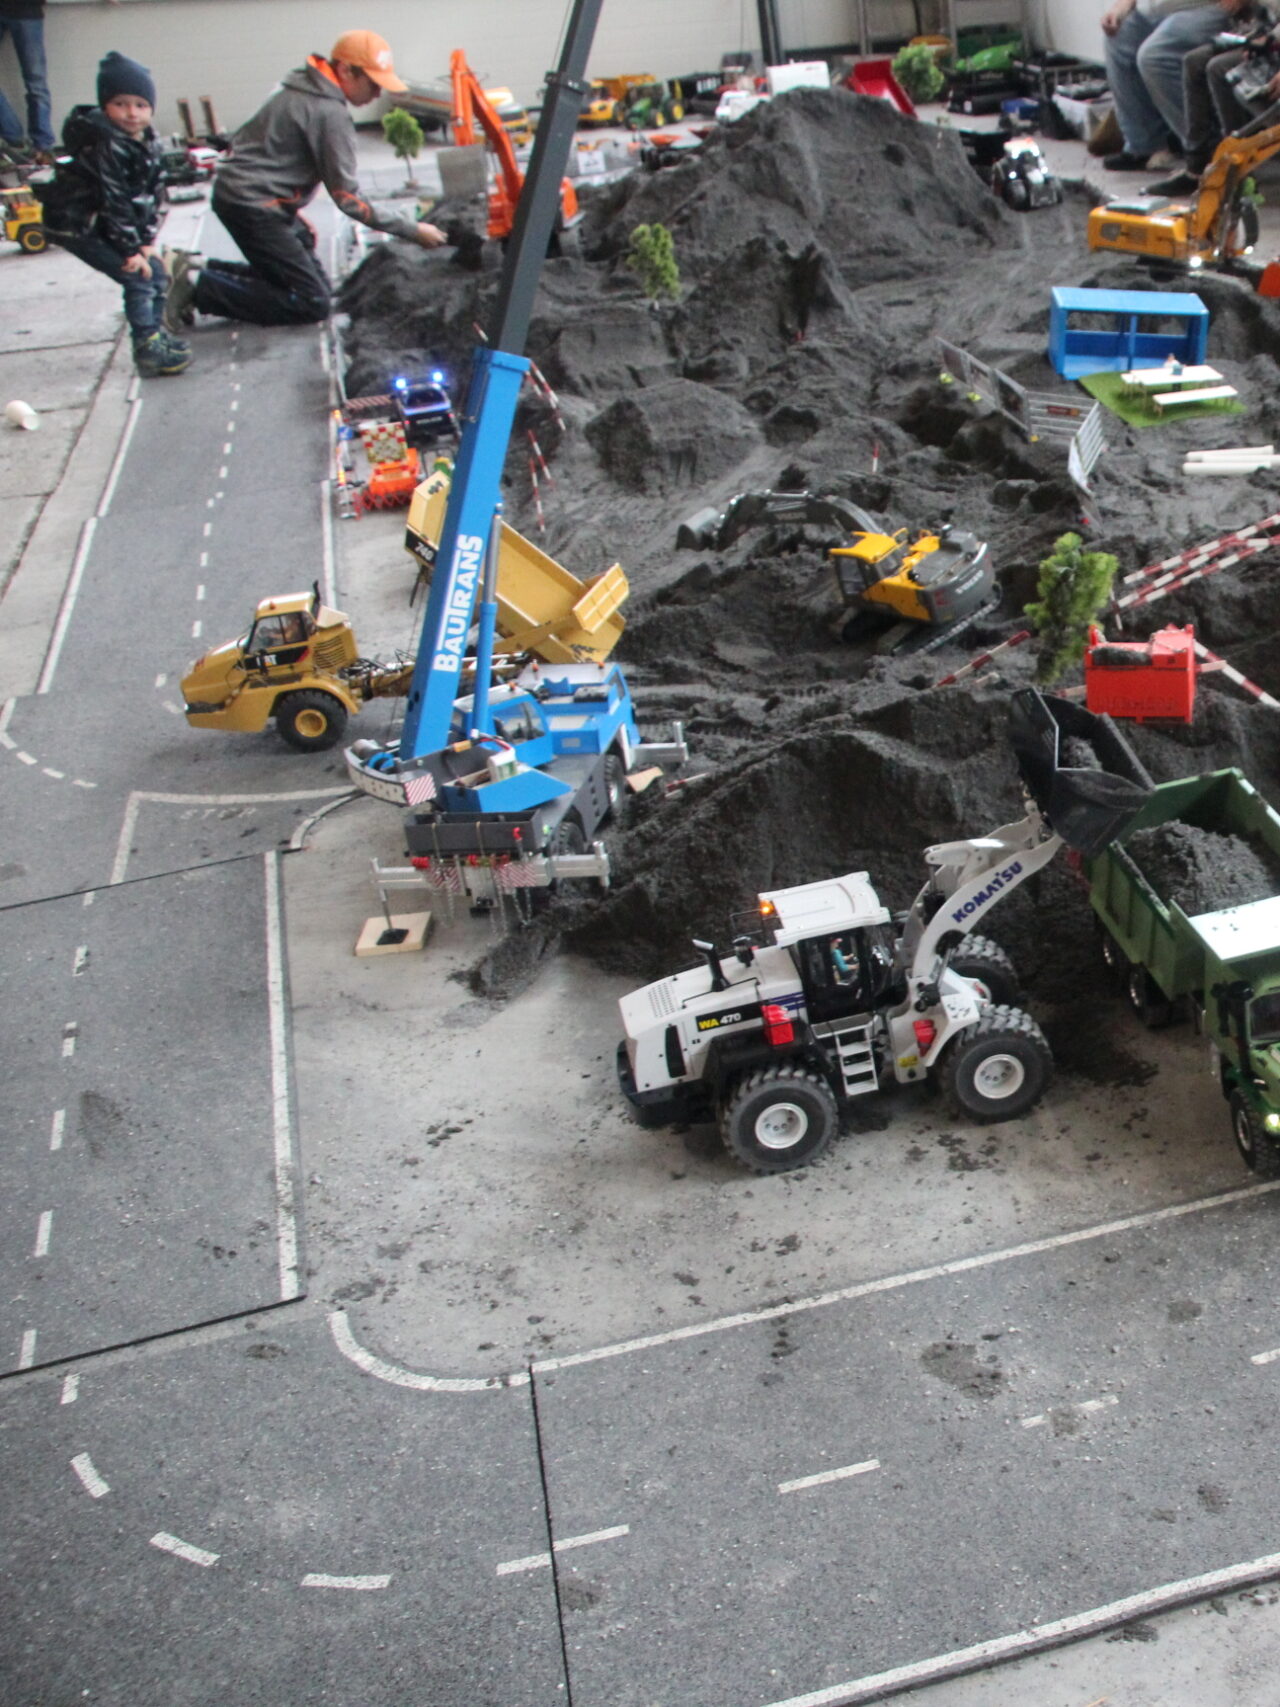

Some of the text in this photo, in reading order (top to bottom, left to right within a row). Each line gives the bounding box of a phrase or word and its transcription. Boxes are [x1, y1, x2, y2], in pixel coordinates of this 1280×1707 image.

[433, 534, 484, 673] BAUTRANS
[951, 860, 1024, 924] KOMATSU
[698, 1012, 742, 1030] WA 470
